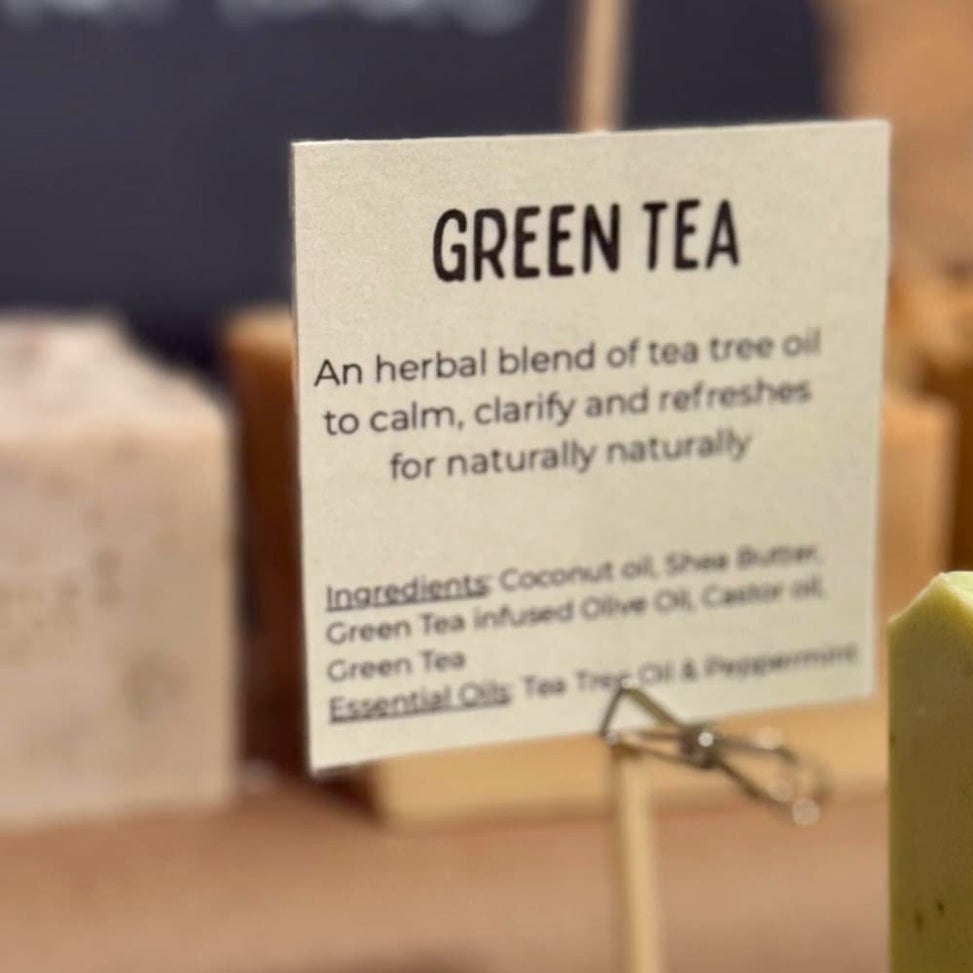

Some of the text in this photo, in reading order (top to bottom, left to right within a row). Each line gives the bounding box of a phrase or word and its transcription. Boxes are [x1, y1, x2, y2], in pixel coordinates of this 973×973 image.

[433, 199, 740, 283] GREEN TEA
[314, 327, 822, 387] An herbal blend of tea tree oil
[323, 375, 813, 436] to calm, clarify and refreshes
[390, 426, 754, 482] for naturally naturally
[500, 560, 614, 592] Coconut
[620, 553, 657, 580] oil,
[664, 551, 729, 577] Shea
[326, 619, 412, 646] Green
[420, 612, 466, 637] Tea
[473, 600, 575, 631] infused
[581, 595, 648, 621] Olive
[701, 582, 784, 609] Castor
[327, 649, 467, 684] Green Tea
[329, 685, 451, 724] Essential
[521, 674, 568, 698] Tea
[637, 661, 675, 687] Oil
[681, 658, 698, 682] &
[704, 641, 859, 679] Peppermint
